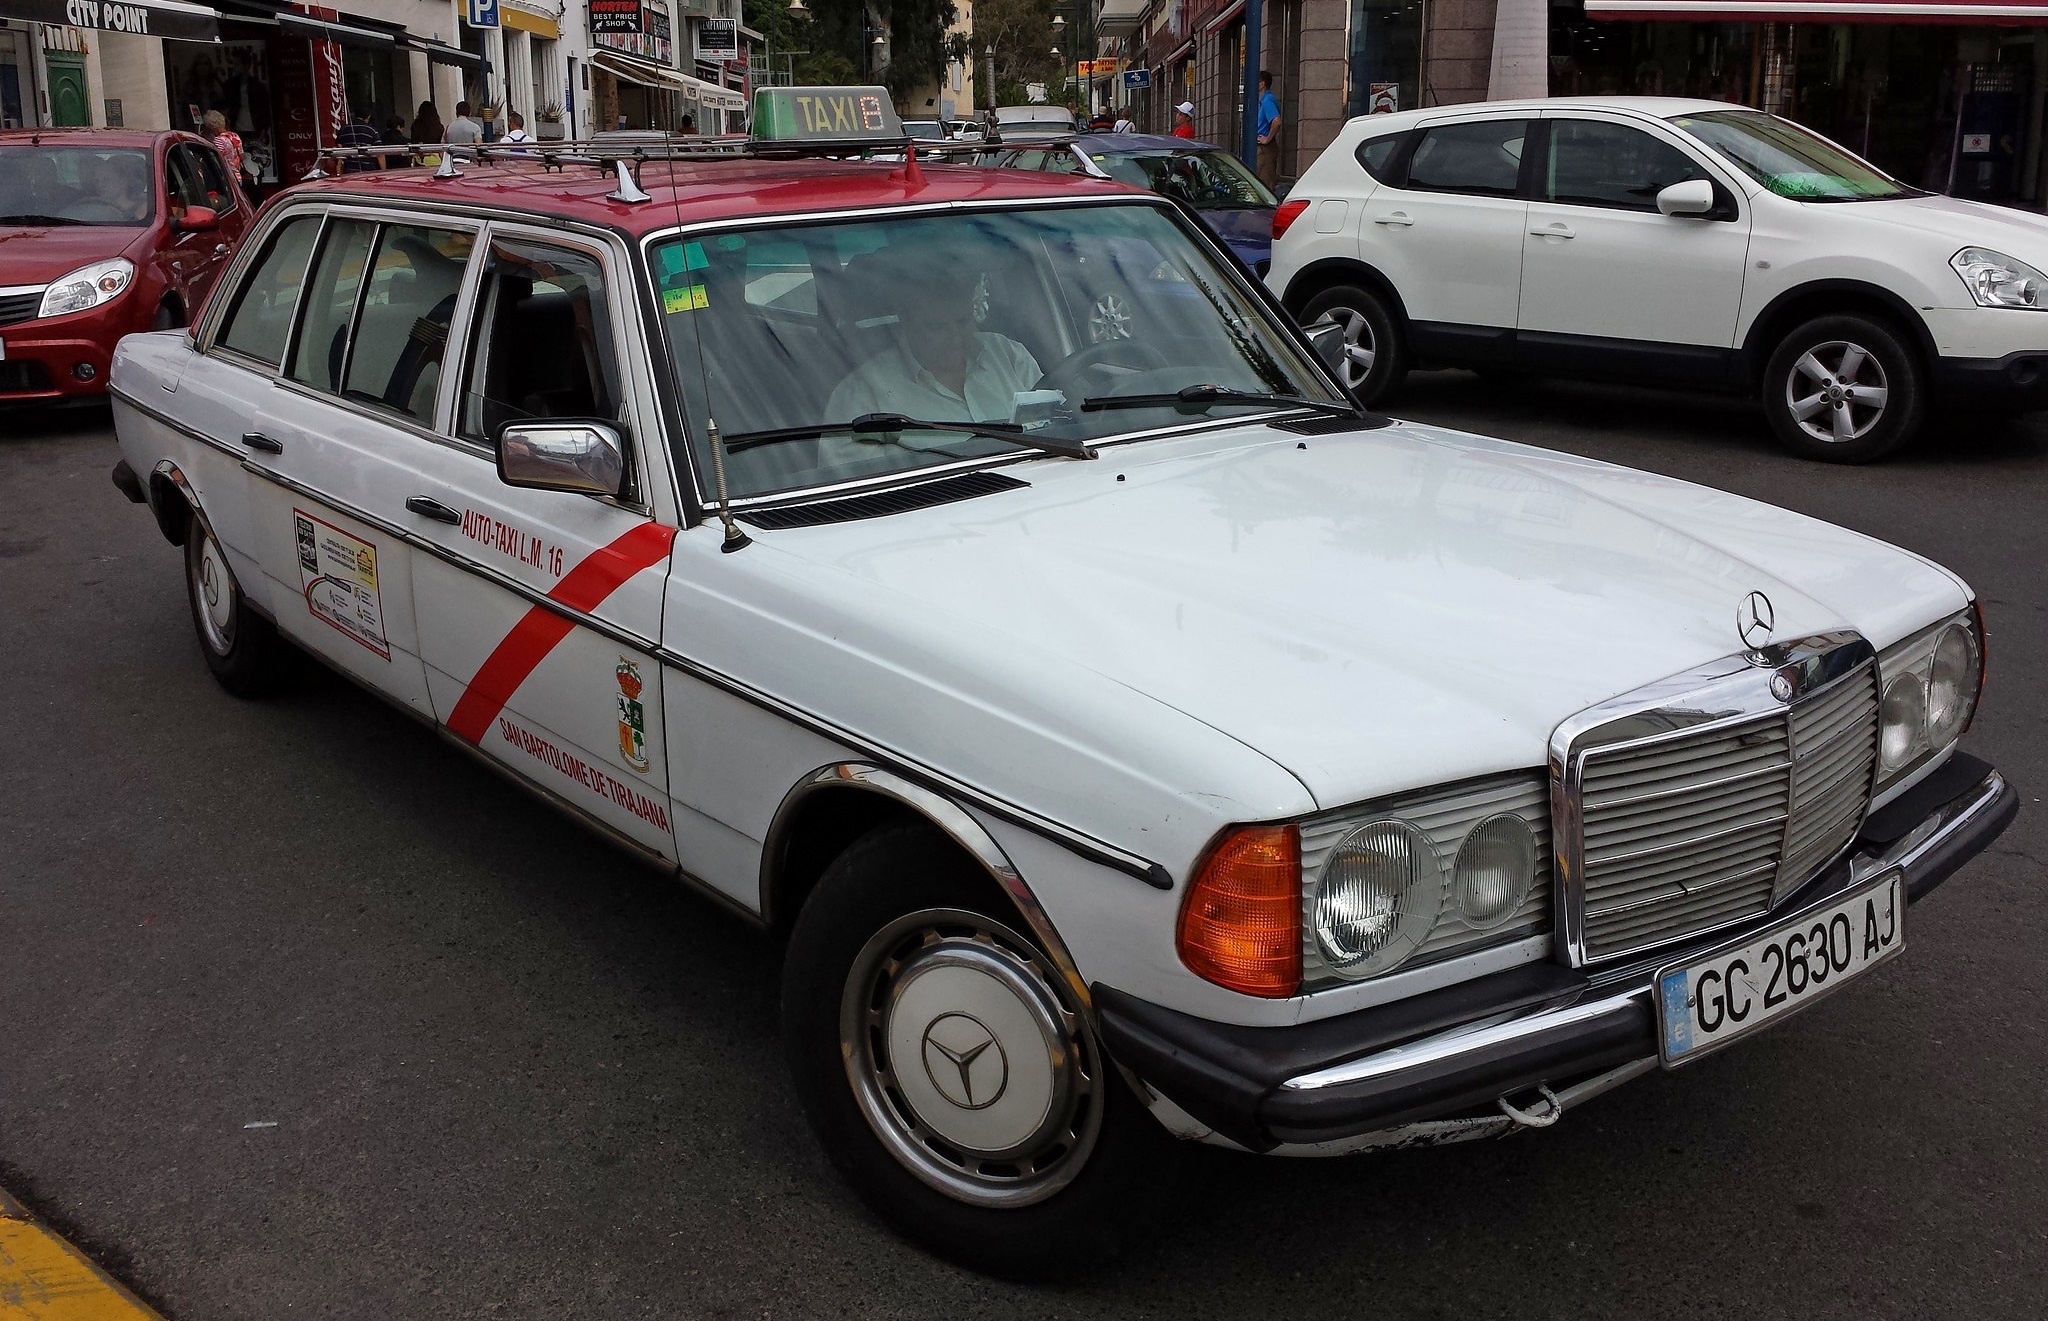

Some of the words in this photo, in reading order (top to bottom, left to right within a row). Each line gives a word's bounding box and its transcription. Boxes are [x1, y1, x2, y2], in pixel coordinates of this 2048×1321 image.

[66, 0, 98, 27] CITY
[104, 3, 147, 33] POINT
[797, 96, 859, 132] TAXI
[462, 509, 518, 557] AUTO-TAXI
[520, 533, 543, 570] L.M.
[549, 546, 563, 577] 16
[500, 717, 523, 749] SAN
[521, 730, 590, 787] BARTOLOME
[589, 766, 608, 797] DE
[606, 776, 671, 834] TIRAJANA
[1696, 959, 1751, 1032] GC
[1761, 913, 1851, 1009] 2630
[1864, 878, 1898, 961] AJ
